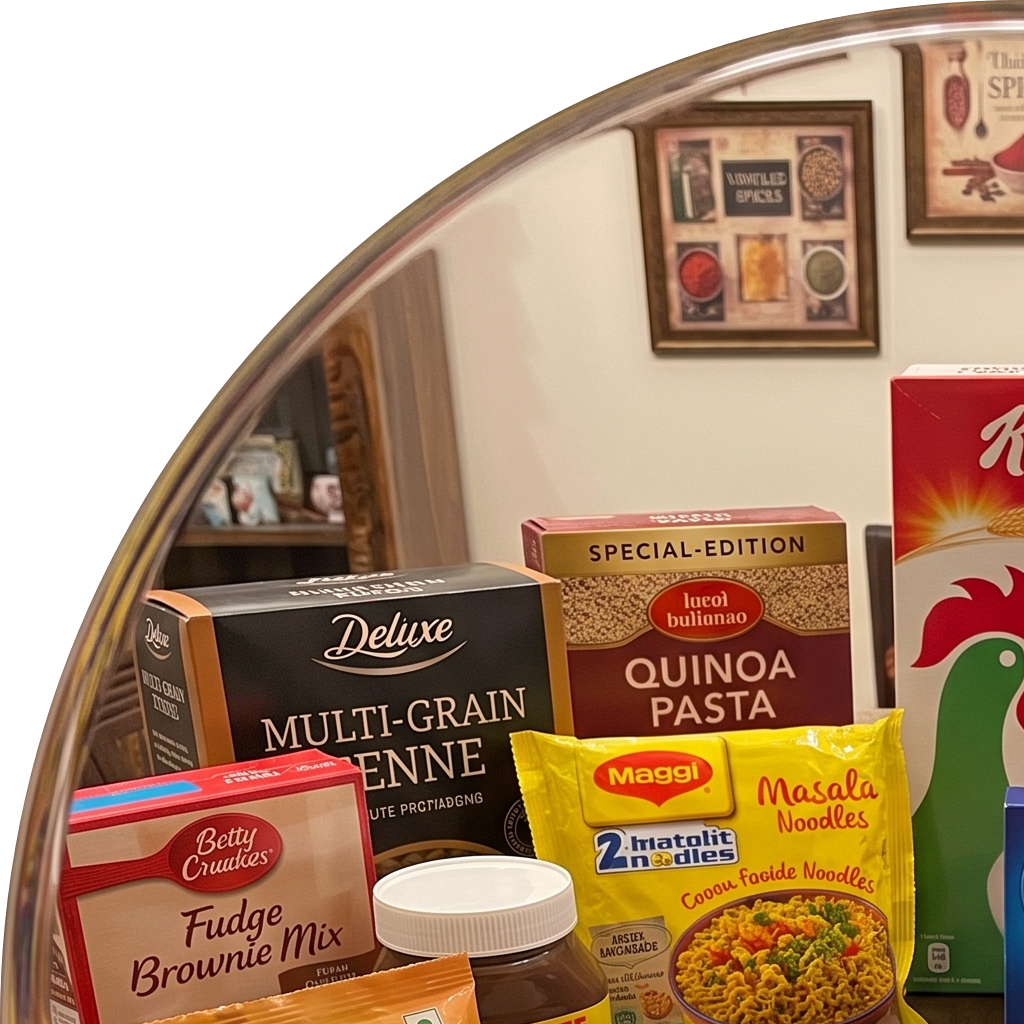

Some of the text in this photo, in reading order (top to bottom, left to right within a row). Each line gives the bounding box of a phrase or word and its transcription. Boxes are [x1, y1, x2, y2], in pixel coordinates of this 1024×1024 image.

[589, 536, 806, 562] SPECIAL-EDITION
[324, 612, 454, 660] Deluxe
[625, 650, 797, 690] QUINOA
[261, 687, 527, 752] MULTI-GRAIN
[650, 690, 777, 727] PASTA
[344, 738, 486, 792] ENNE
[608, 762, 699, 786] Maggi
[757, 768, 878, 806] Masala
[777, 805, 869, 834] Noodles
[196, 826, 258, 856] Betty
[803, 861, 875, 895] Noodles
[181, 898, 283, 949] Fudge
[281, 923, 344, 962] Mix
[131, 943, 273, 998] Brownie
